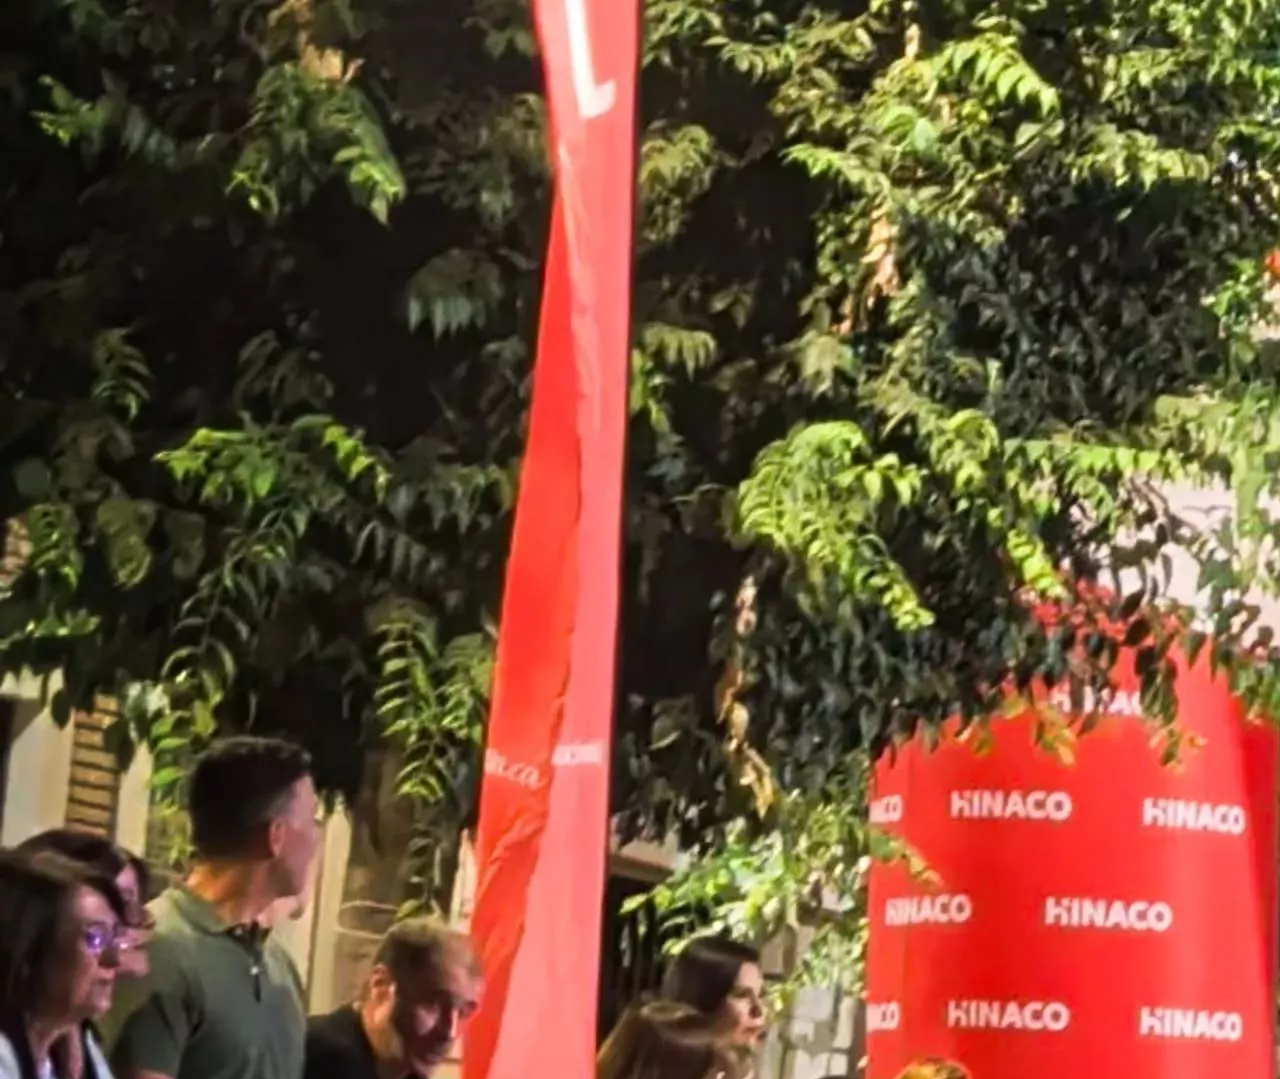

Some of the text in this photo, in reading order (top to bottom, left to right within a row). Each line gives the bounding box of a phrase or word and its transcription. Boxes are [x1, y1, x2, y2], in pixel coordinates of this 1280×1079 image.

[950, 788, 1073, 822] HINACO
[1142, 797, 1246, 835] HINACO
[885, 893, 973, 927] HINACO
[1044, 896, 1174, 932] HINACO
[946, 999, 1070, 1032] HINACO
[1139, 1006, 1243, 1041] HINACO
